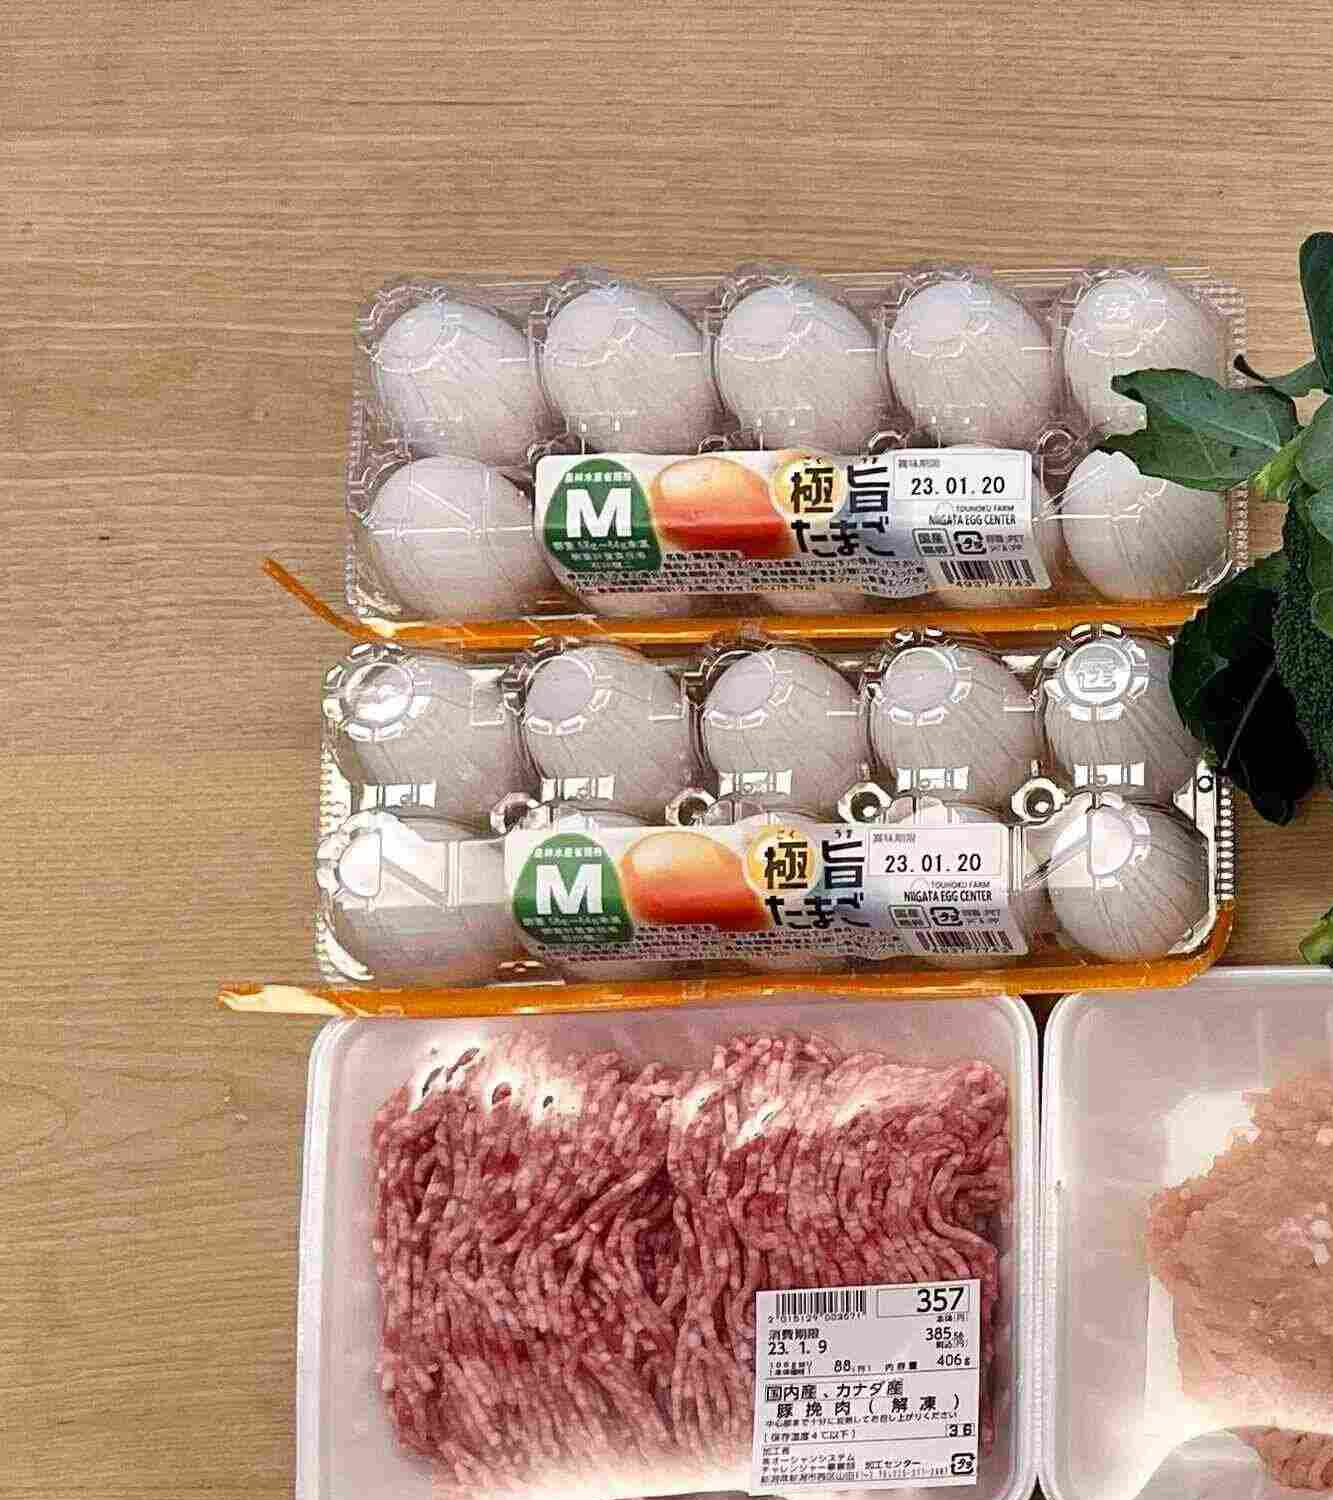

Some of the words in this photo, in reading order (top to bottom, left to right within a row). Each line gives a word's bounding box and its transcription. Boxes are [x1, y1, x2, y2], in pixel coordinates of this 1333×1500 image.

[790, 464, 890, 513] 極旨
[911, 476, 1005, 496] 23.01.20
[566, 488, 632, 538] M
[965, 514, 983, 526] EGG
[984, 514, 1016, 526] CENTER
[791, 519, 897, 558] たまご
[764, 839, 865, 889] 極旨
[885, 853, 981, 873] 23.01.20
[536, 863, 603, 915] M
[904, 890, 938, 903] NIIGATA
[941, 891, 958, 902] EGG
[960, 891, 992, 902] CENTER
[769, 895, 873, 929] たまご
[917, 1288, 965, 1313] 357
[769, 1329, 819, 1340] 消費期限
[769, 1340, 828, 1355] 23.1.9
[937, 1354, 970, 1367] 406g
[766, 1380, 903, 1401] 国内産、カナダ産
